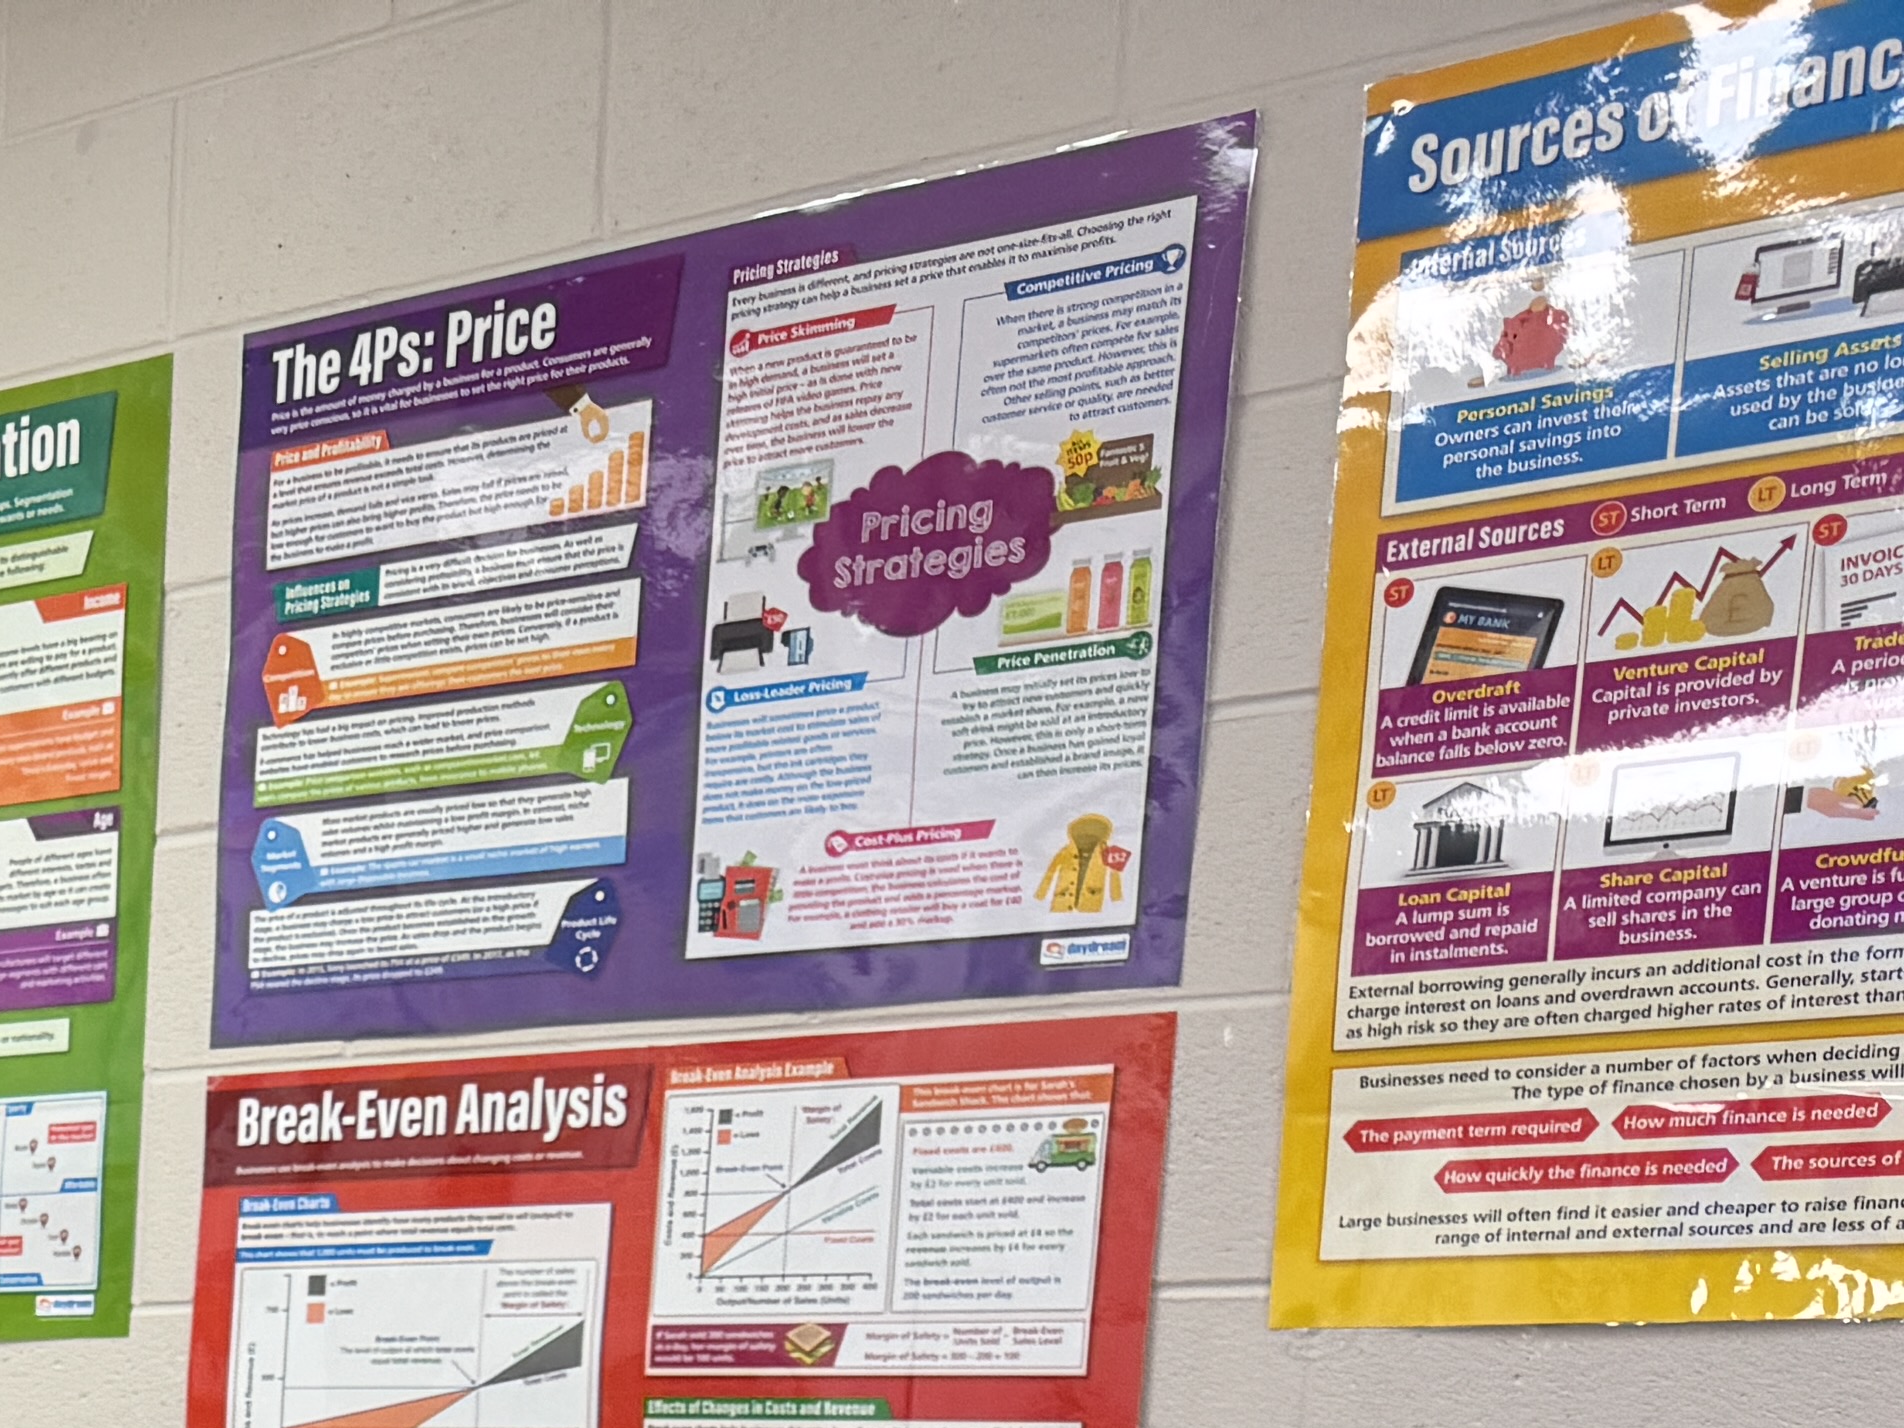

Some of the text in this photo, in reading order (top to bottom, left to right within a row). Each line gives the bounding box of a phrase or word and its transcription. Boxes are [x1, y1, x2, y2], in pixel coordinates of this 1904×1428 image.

[1405, 100, 1626, 196] Sources
[1015, 257, 1154, 298] Competitive Pricing
[271, 299, 557, 405] The 4Ps: Price
[1456, 385, 1614, 425] Personal Savings
[1066, 450, 1093, 470] 50p
[1790, 468, 1888, 500] Long Term
[1630, 496, 1727, 525] Short Term
[833, 497, 1027, 588] Pricing Strategies
[1384, 516, 1565, 564] External Sources
[1612, 648, 1765, 682] Venture Capital
[1431, 679, 1521, 705] Overdraft
[92, 810, 115, 830] Age
[1599, 862, 1728, 888] Share Capital
[1397, 883, 1512, 908] Loan Capital
[235, 1073, 629, 1148] Break-Even Analysis
[1359, 1118, 1583, 1146] The payment term required
